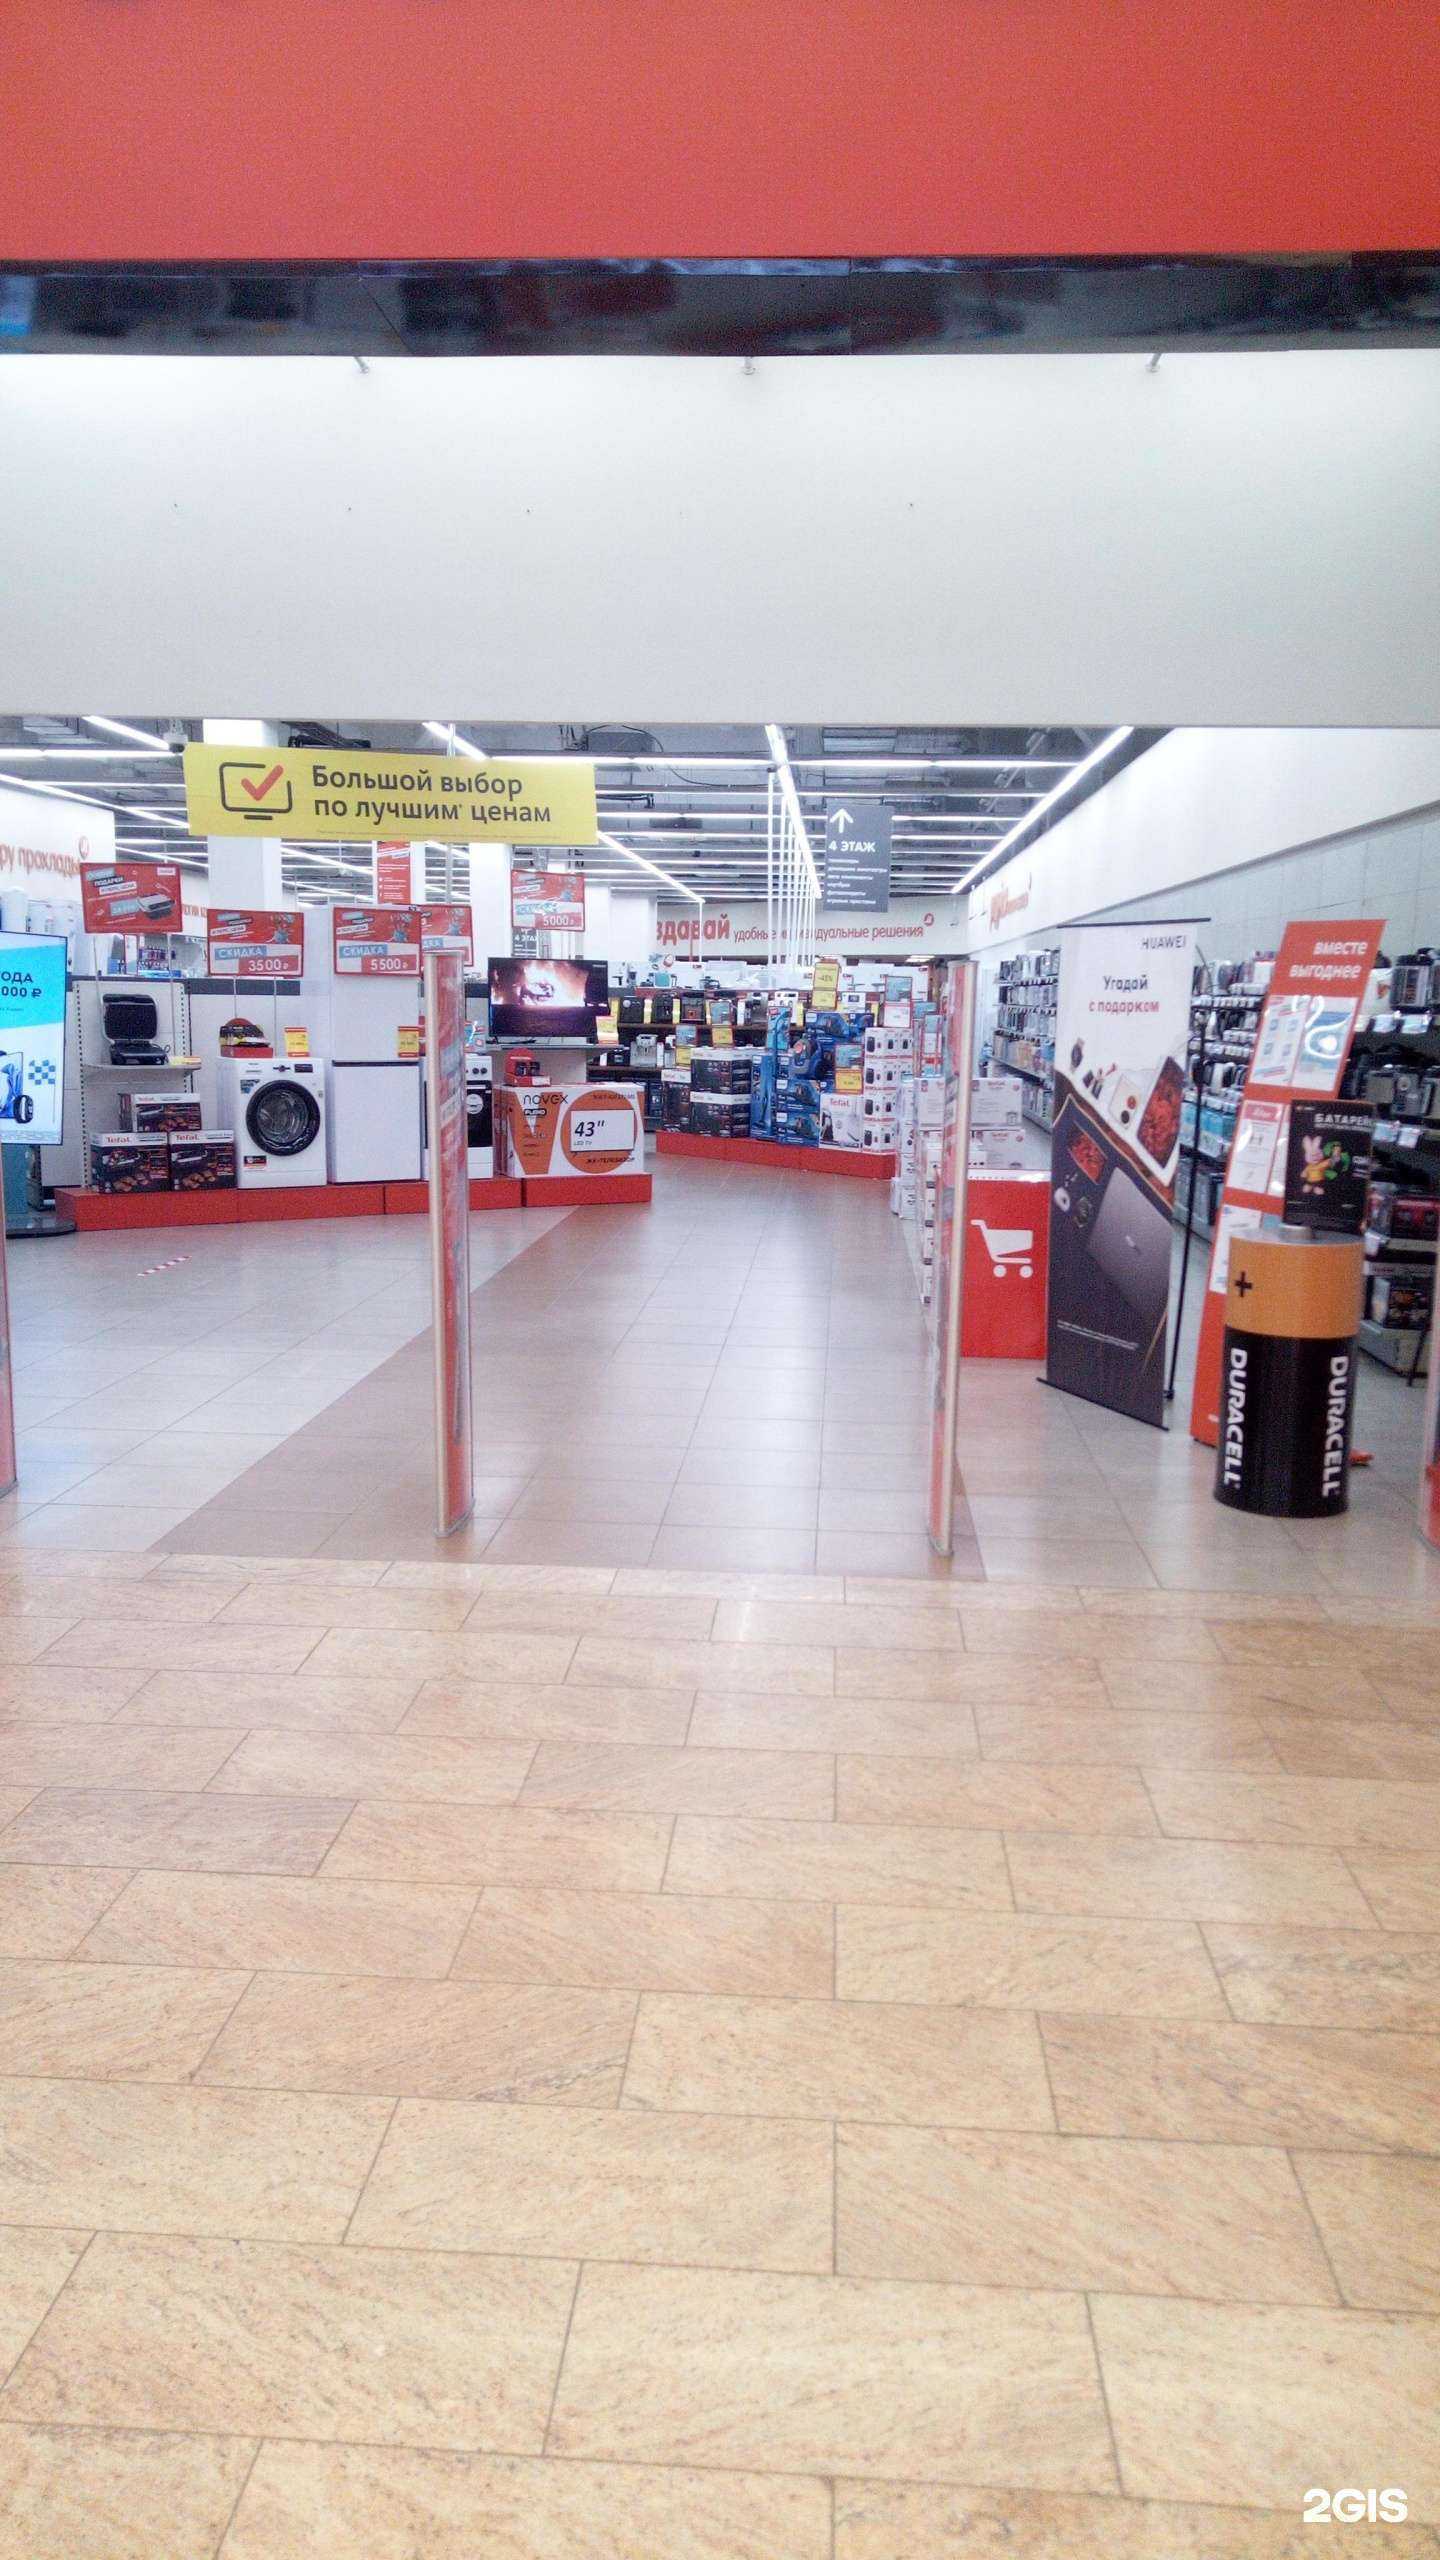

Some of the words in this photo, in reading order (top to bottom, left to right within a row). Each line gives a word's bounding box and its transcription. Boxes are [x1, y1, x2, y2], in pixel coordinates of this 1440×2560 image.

[312, 764, 432, 793] Большой
[441, 771, 523, 804] выбор
[314, 799, 347, 818] по
[471, 804, 551, 825] ценам
[828, 840, 838, 851] 4
[840, 841, 876, 853] ЭТАЖ
[543, 914, 569, 926] 5000
[872, 927, 924, 941] решения
[1141, 935, 1187, 949] HUAWEI
[1313, 941, 1369, 956] вместе
[248, 959, 282, 972] 3500
[370, 957, 401, 971] 5500
[1, 971, 34, 984] ОДА
[1289, 963, 1362, 981] выгоднее
[1103, 974, 1149, 993] Угадай
[1, 986, 28, 998] 000
[1088, 1001, 1095, 1012] с
[1097, 1001, 1160, 1015] подарком
[574, 1119, 605, 1137] 43"
[106, 1136, 132, 1144] Tefal
[1224, 1347, 1248, 1486] DURACELL
[1322, 1355, 1349, 1498] DURACELL
